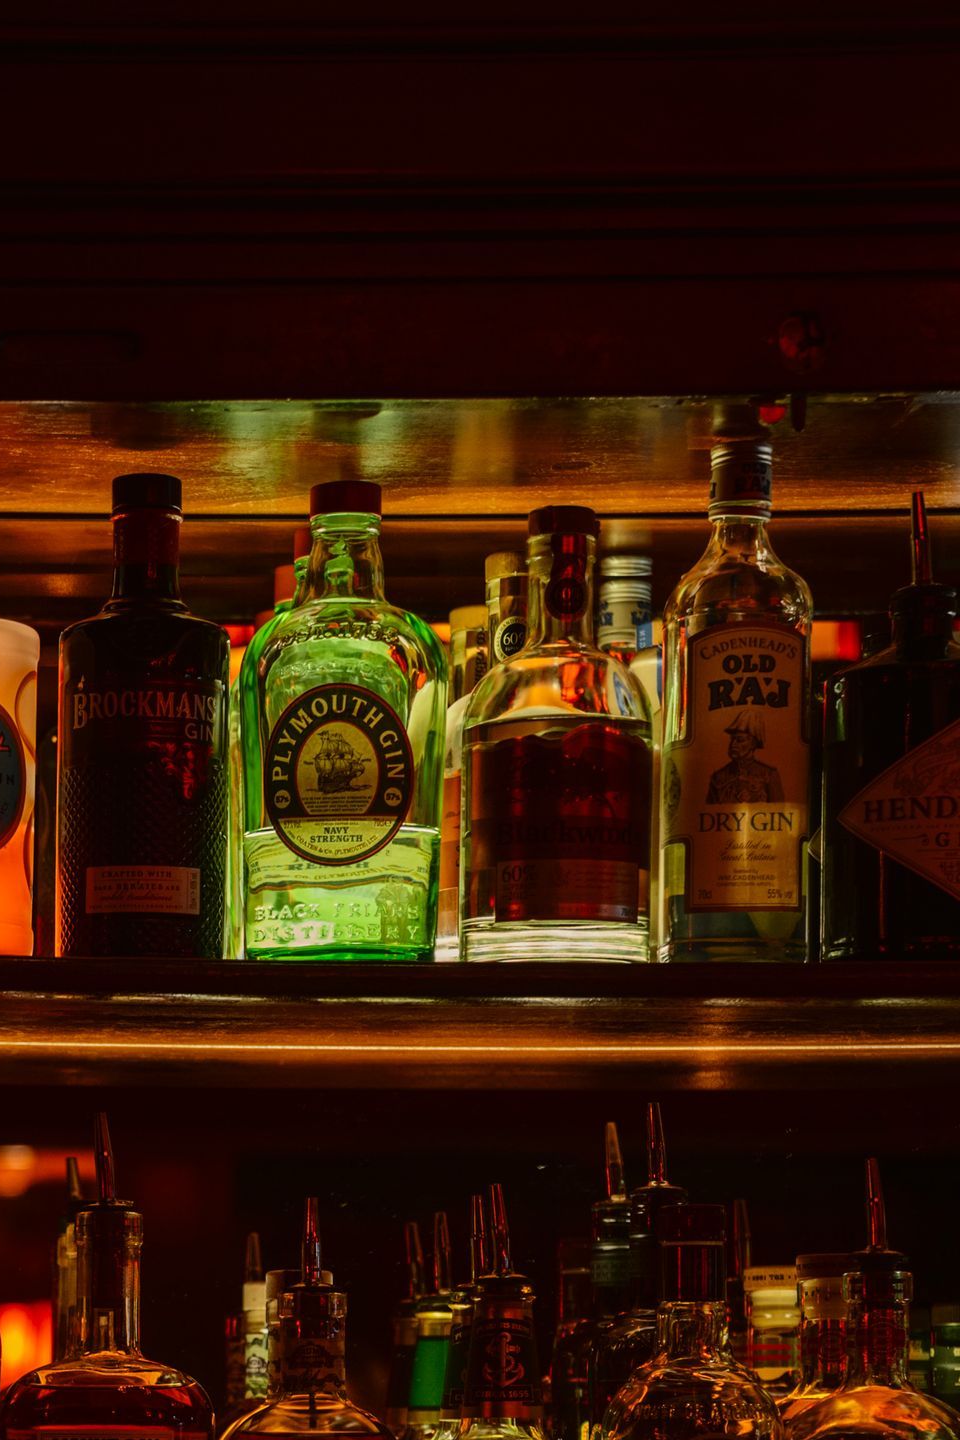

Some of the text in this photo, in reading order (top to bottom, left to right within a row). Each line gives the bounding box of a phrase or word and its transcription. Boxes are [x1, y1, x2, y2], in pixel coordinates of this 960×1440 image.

[700, 636, 797, 660] CADENHEAD'S
[722, 654, 776, 674] OLD
[73, 690, 216, 729] BROCKMANS
[272, 694, 406, 782] PLYMOUTH GIN
[323, 826, 350, 835] NAVY
[698, 811, 794, 832] DRY GIN
[310, 835, 363, 844] STRENGTH
[254, 903, 320, 921] BLACK
